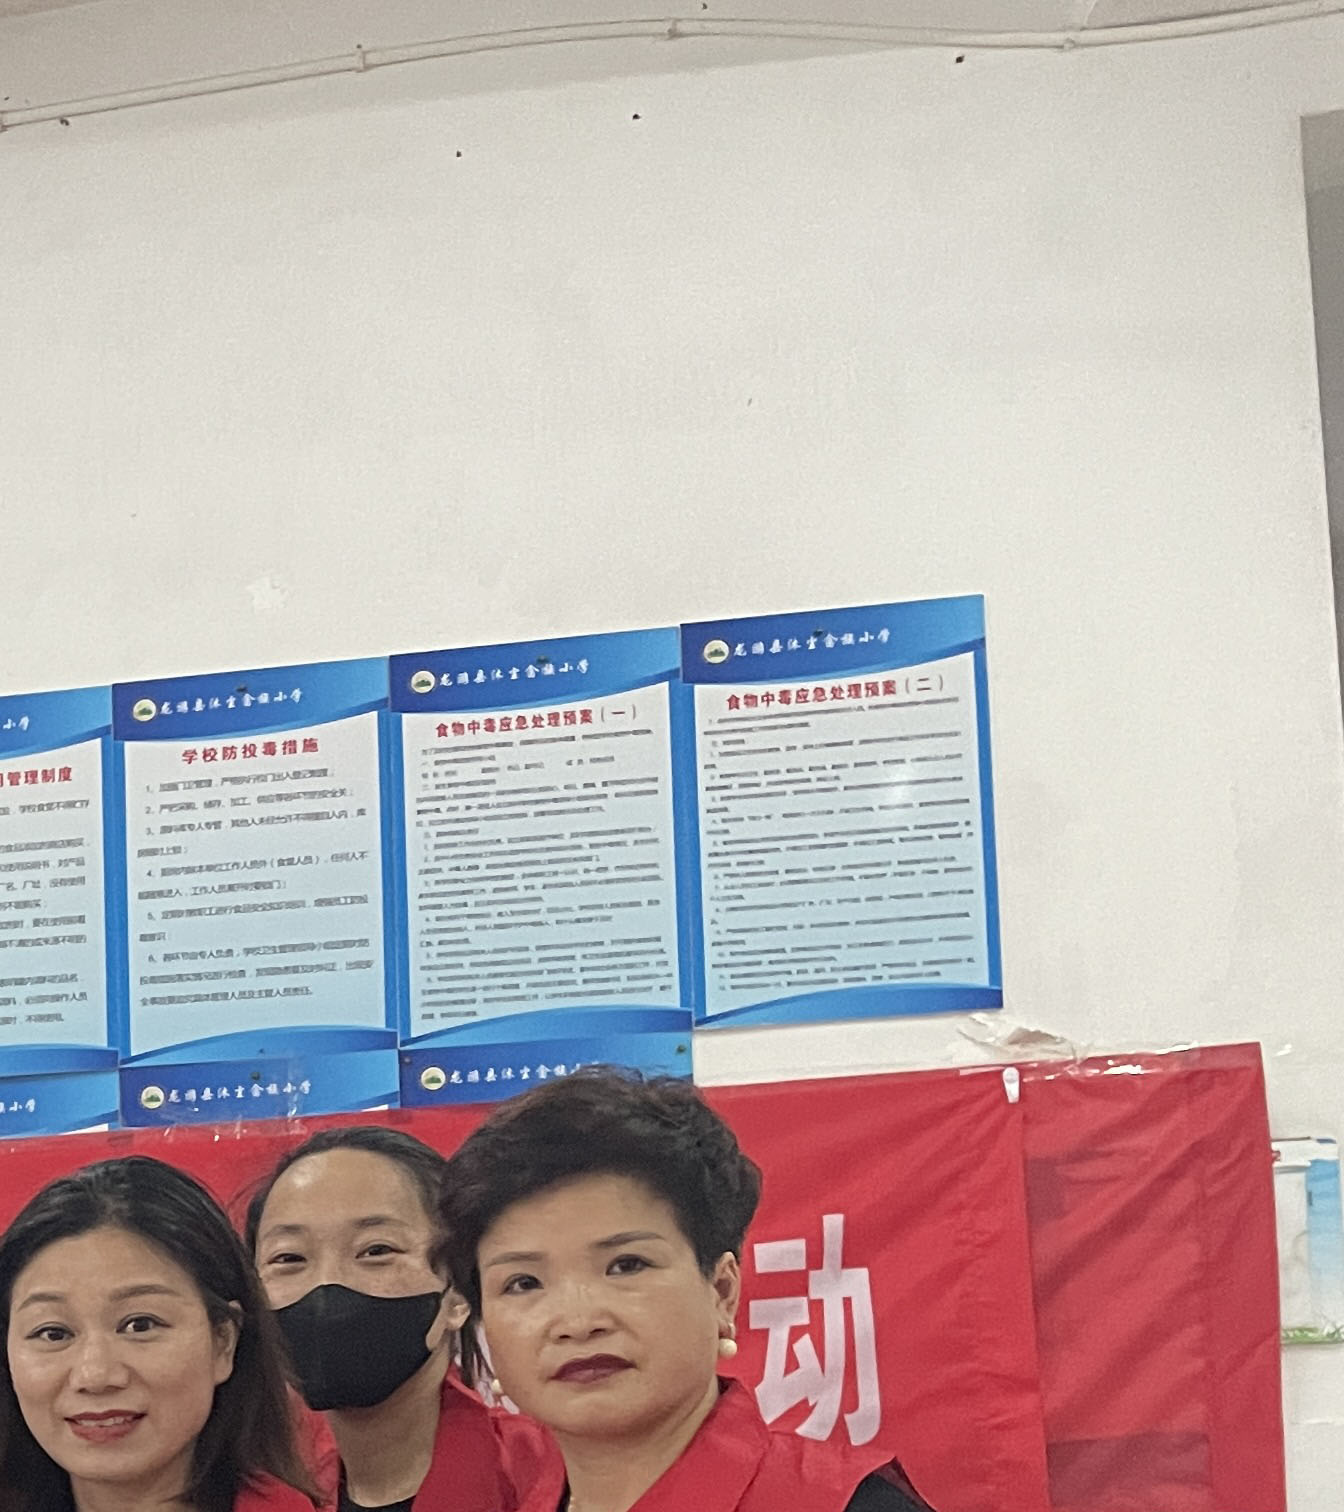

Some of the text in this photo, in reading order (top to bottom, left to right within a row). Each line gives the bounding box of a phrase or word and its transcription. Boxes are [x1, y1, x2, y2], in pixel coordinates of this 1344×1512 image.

[181, 738, 319, 765] 学校防投毒措施
[748, 1213, 883, 1447] 动
